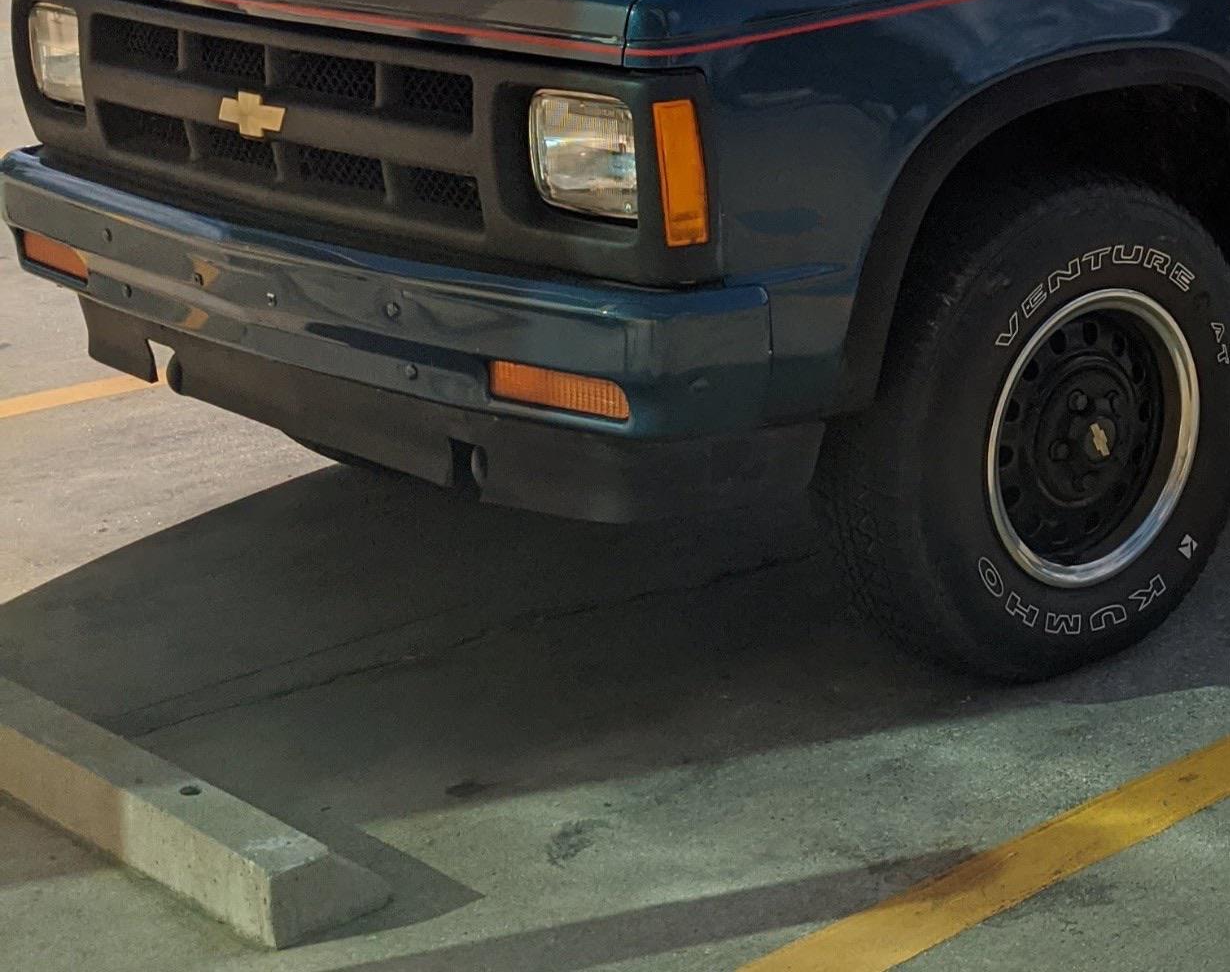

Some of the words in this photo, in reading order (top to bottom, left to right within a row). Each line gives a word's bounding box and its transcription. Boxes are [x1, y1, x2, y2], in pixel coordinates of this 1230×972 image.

[995, 244, 1196, 347] VENTURE
[1210, 321, 1230, 365] AT
[978, 556, 1167, 635] KUMHO
